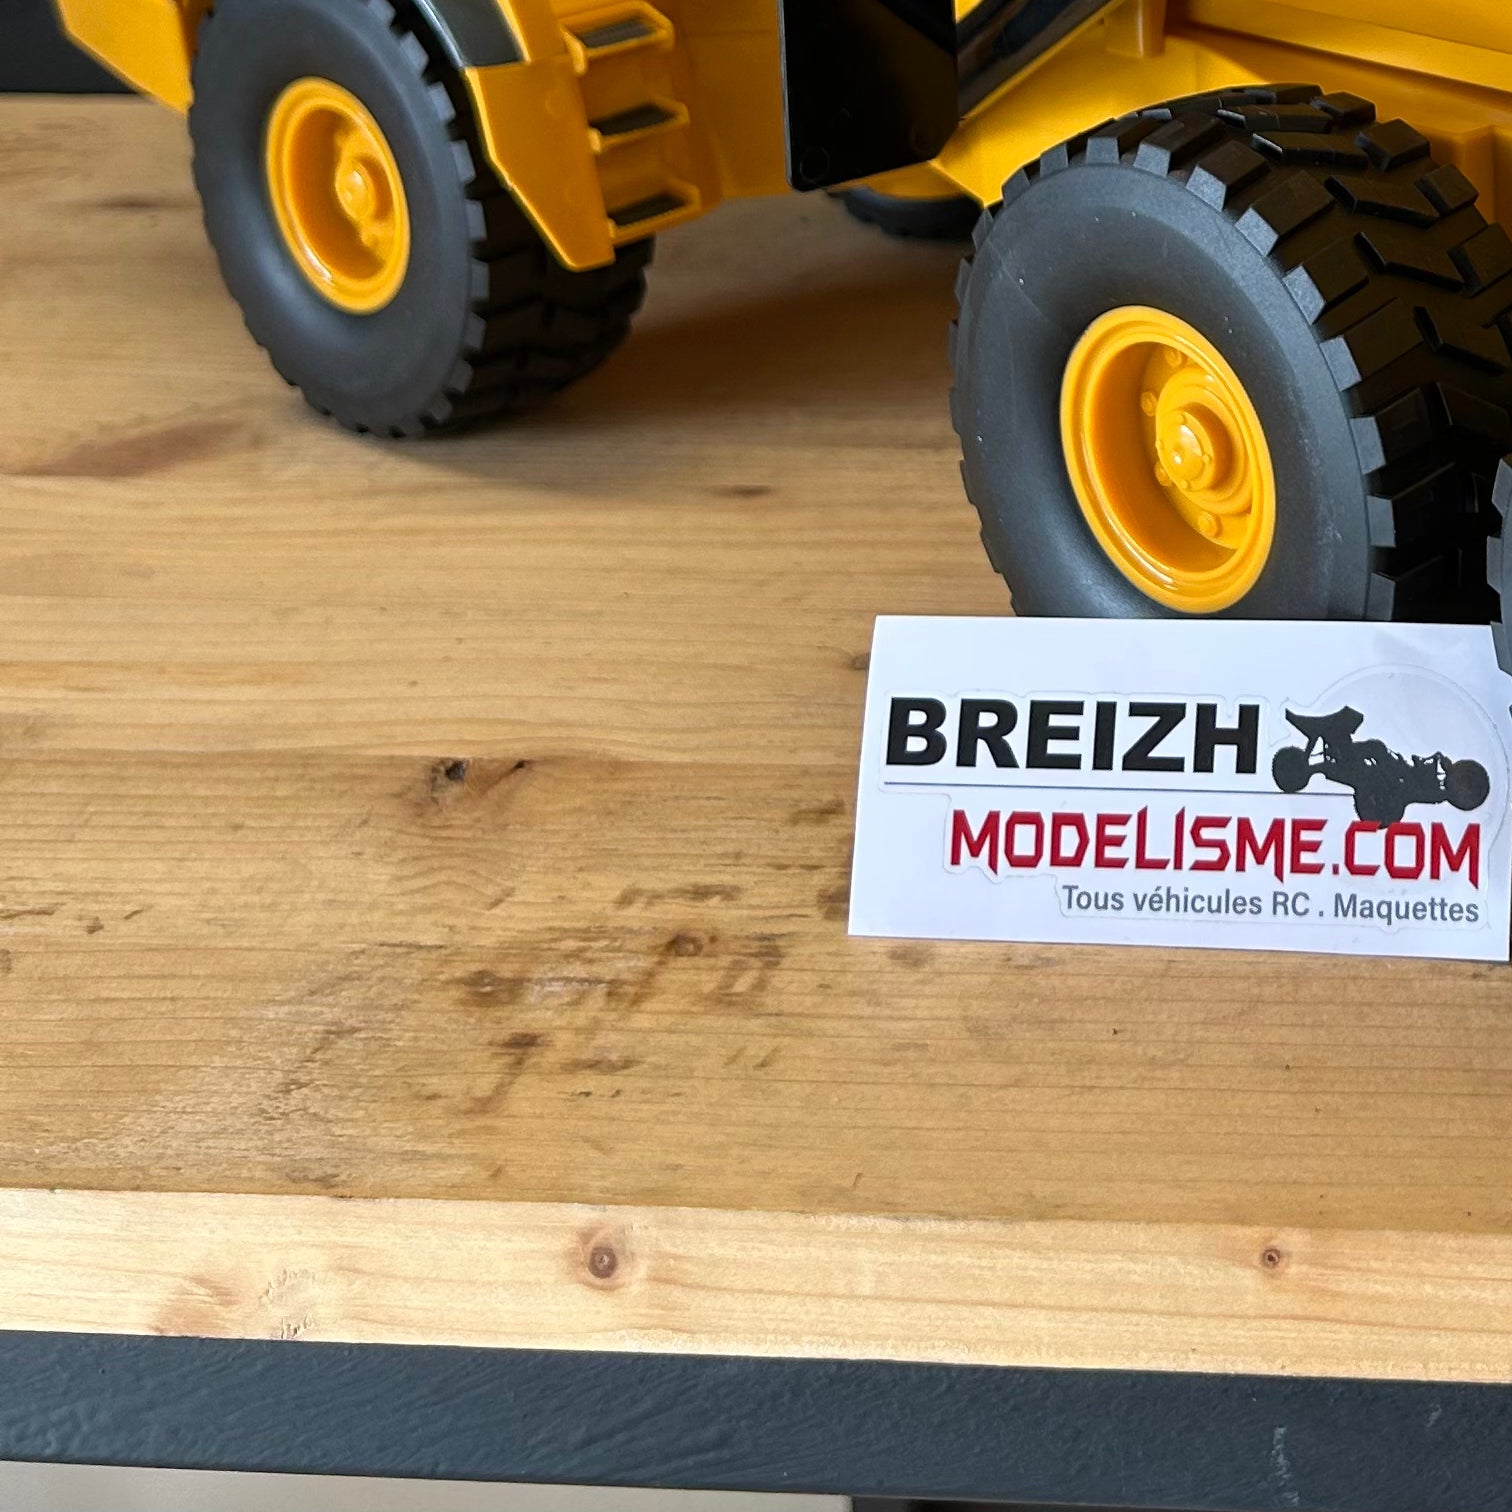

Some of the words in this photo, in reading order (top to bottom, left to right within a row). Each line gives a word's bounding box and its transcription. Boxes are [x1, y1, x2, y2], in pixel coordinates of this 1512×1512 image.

[885, 696, 1260, 775] BREIZH
[949, 806, 1481, 891] MODELISME.COM
[1062, 885, 1125, 912] Tous
[1134, 886, 1264, 917] véhicules
[1271, 892, 1311, 916] RC
[1333, 894, 1480, 926] Maquettes
